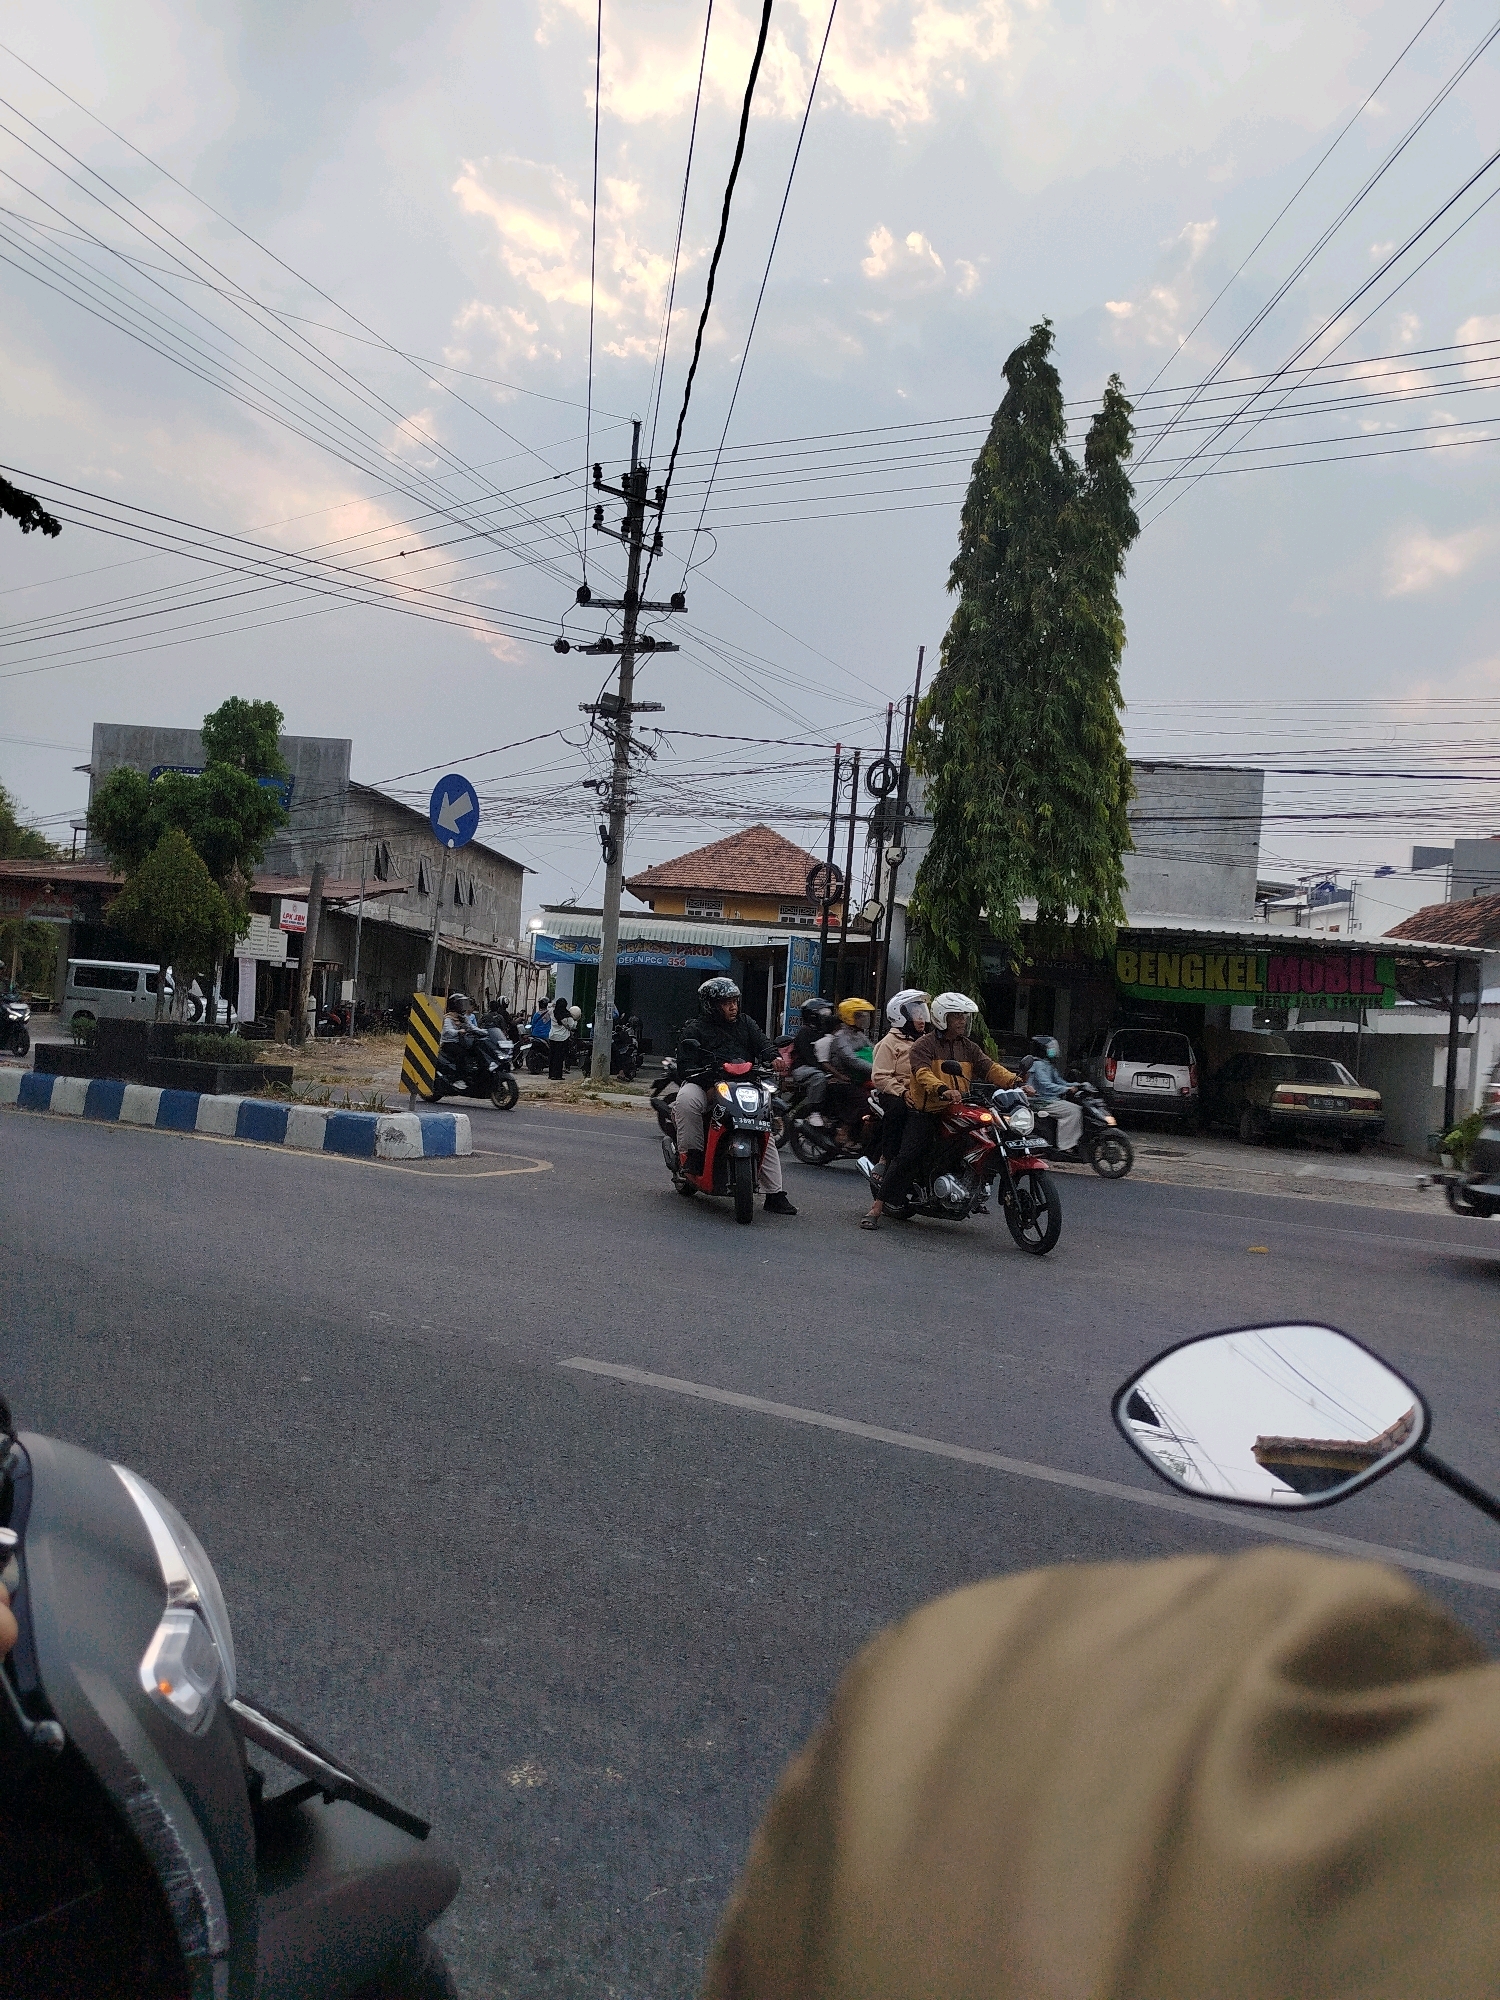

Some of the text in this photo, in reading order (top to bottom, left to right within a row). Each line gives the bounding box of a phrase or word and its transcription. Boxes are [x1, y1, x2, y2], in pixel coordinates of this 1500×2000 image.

[553, 940, 578, 954] MIE
[580, 943, 622, 955] AY
[625, 942, 672, 956] BAKSO
[667, 957, 687, 967] 354
[1115, 949, 1384, 995] BENGKEL MOBIL
